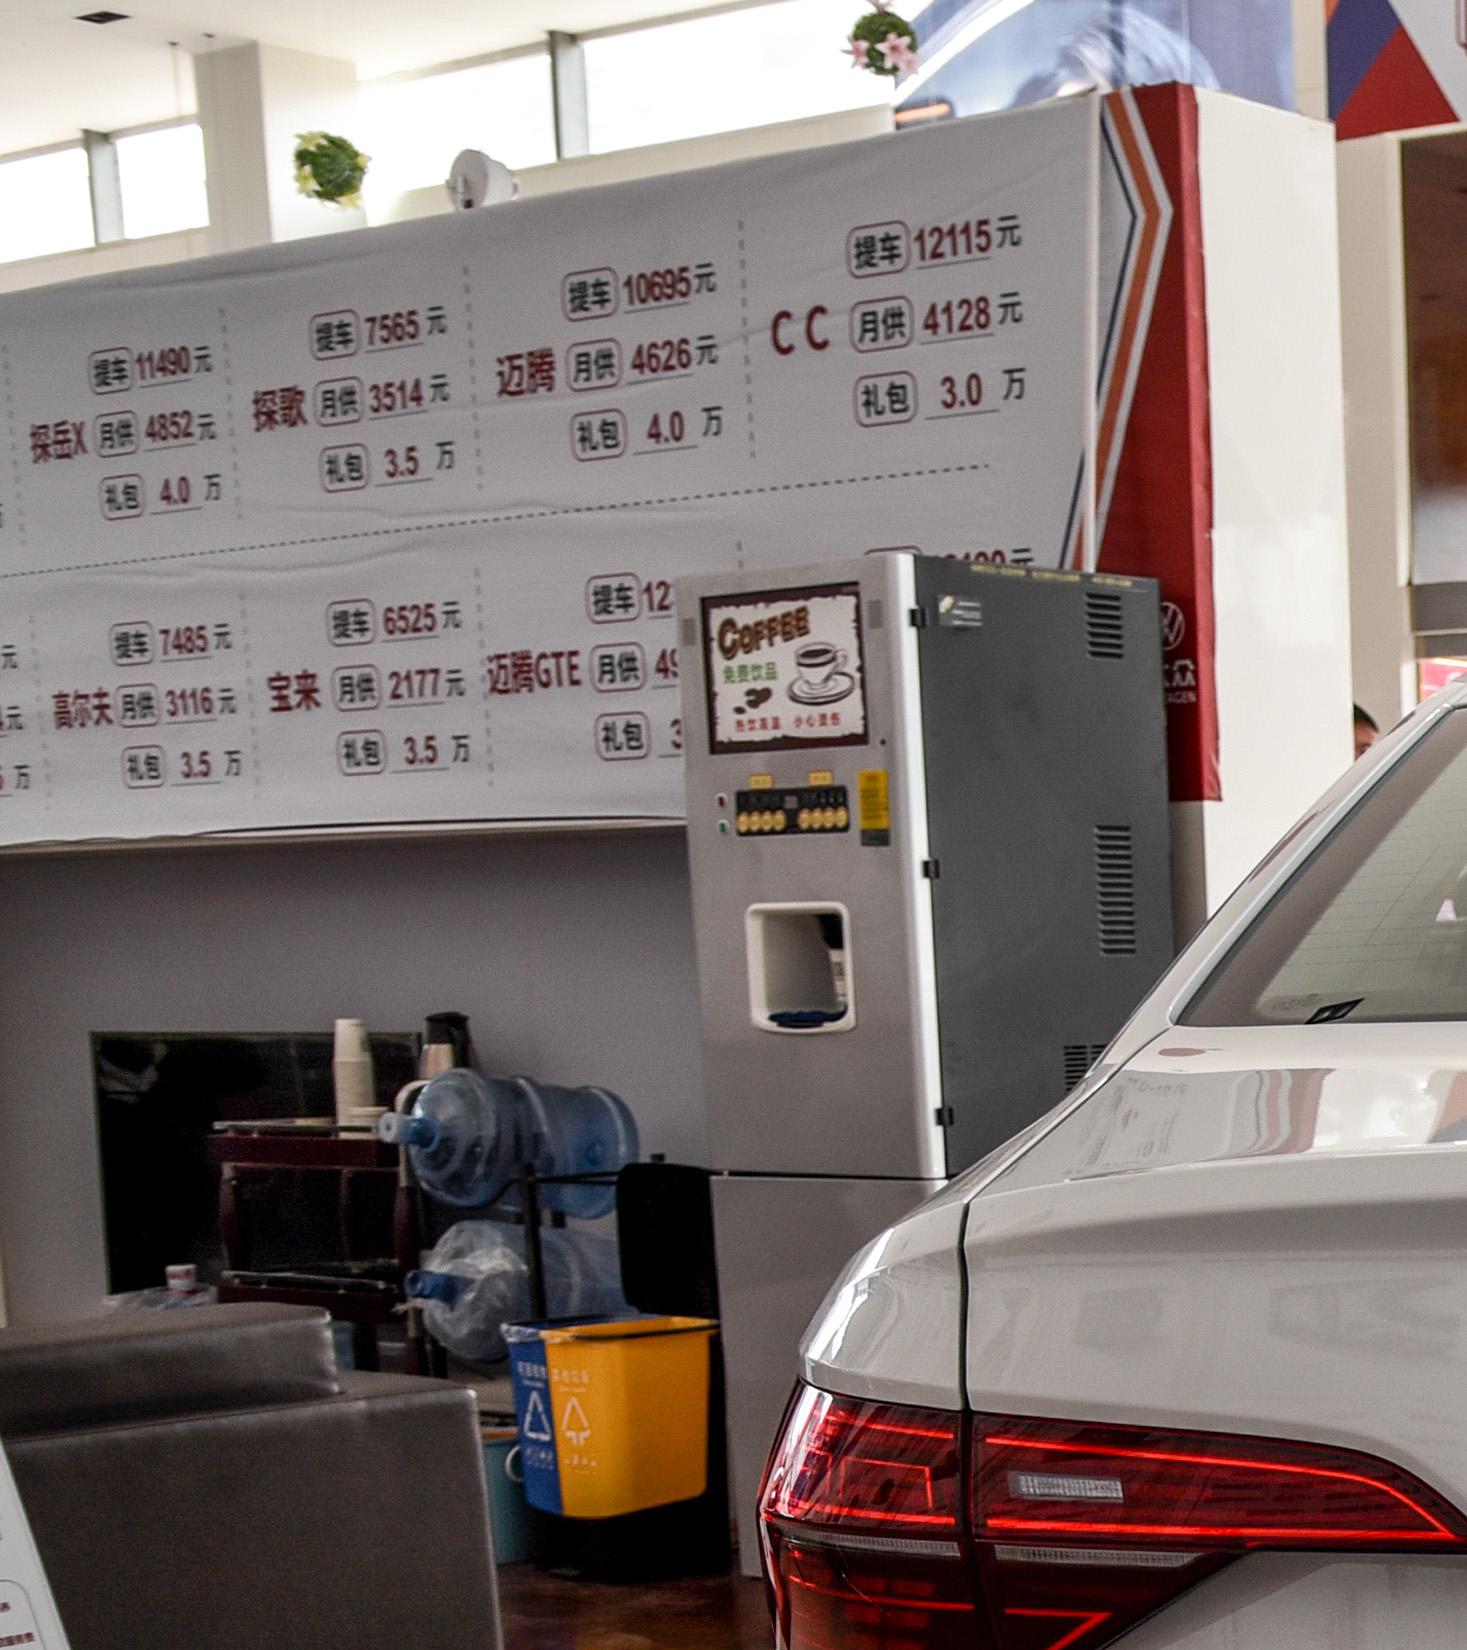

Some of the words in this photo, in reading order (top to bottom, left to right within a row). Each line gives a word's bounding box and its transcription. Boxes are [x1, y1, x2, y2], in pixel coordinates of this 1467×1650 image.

[854, 231, 902, 270] 提车
[914, 218, 992, 261] 12115
[996, 214, 1022, 248] 元
[568, 277, 611, 313] 提车
[623, 265, 692, 306] 10695
[694, 262, 717, 294] 元
[365, 309, 420, 345] 7565
[426, 305, 448, 335] 元
[858, 306, 906, 344] 月供
[923, 296, 991, 335] 4128
[998, 291, 1023, 325] 元
[135, 345, 191, 380] 11490
[496, 347, 557, 398] 迈腾
[573, 347, 615, 383] 月供
[631, 338, 692, 374] 4626
[696, 334, 718, 366] 元
[321, 385, 359, 418] 月供
[369, 378, 423, 414] 3514
[429, 373, 450, 403] 元
[861, 381, 910, 418] 礼包
[940, 373, 983, 409] 3.0
[1002, 367, 1026, 401] 万
[100, 418, 134, 449] 月供
[145, 410, 194, 442] 4852
[576, 418, 620, 452] 礼包
[646, 410, 685, 444] 4.0
[701, 405, 723, 438] 万
[326, 452, 363, 484] 礼包
[384, 446, 420, 478] 3.5
[435, 440, 455, 470] 万
[160, 476, 190, 505] 4.0
[204, 473, 221, 501] 万
[383, 602, 437, 636] 6525
[442, 600, 462, 629] 元
[592, 582, 635, 616] 提车
[159, 625, 208, 655] 7485
[339, 672, 375, 703] 月供
[388, 667, 440, 700] 2177
[446, 669, 466, 697] 元
[487, 650, 583, 694] 迈腾GTE
[598, 650, 639, 684] 月供
[52, 686, 113, 730] 高尔夫
[165, 687, 214, 717] 3116
[267, 669, 321, 712] 宝来
[343, 736, 381, 768] 礼包
[404, 735, 438, 765] 3.5
[451, 734, 470, 762] 万
[602, 720, 643, 752] 礼包
[181, 750, 212, 779] 3.5
[224, 749, 242, 777] 万
